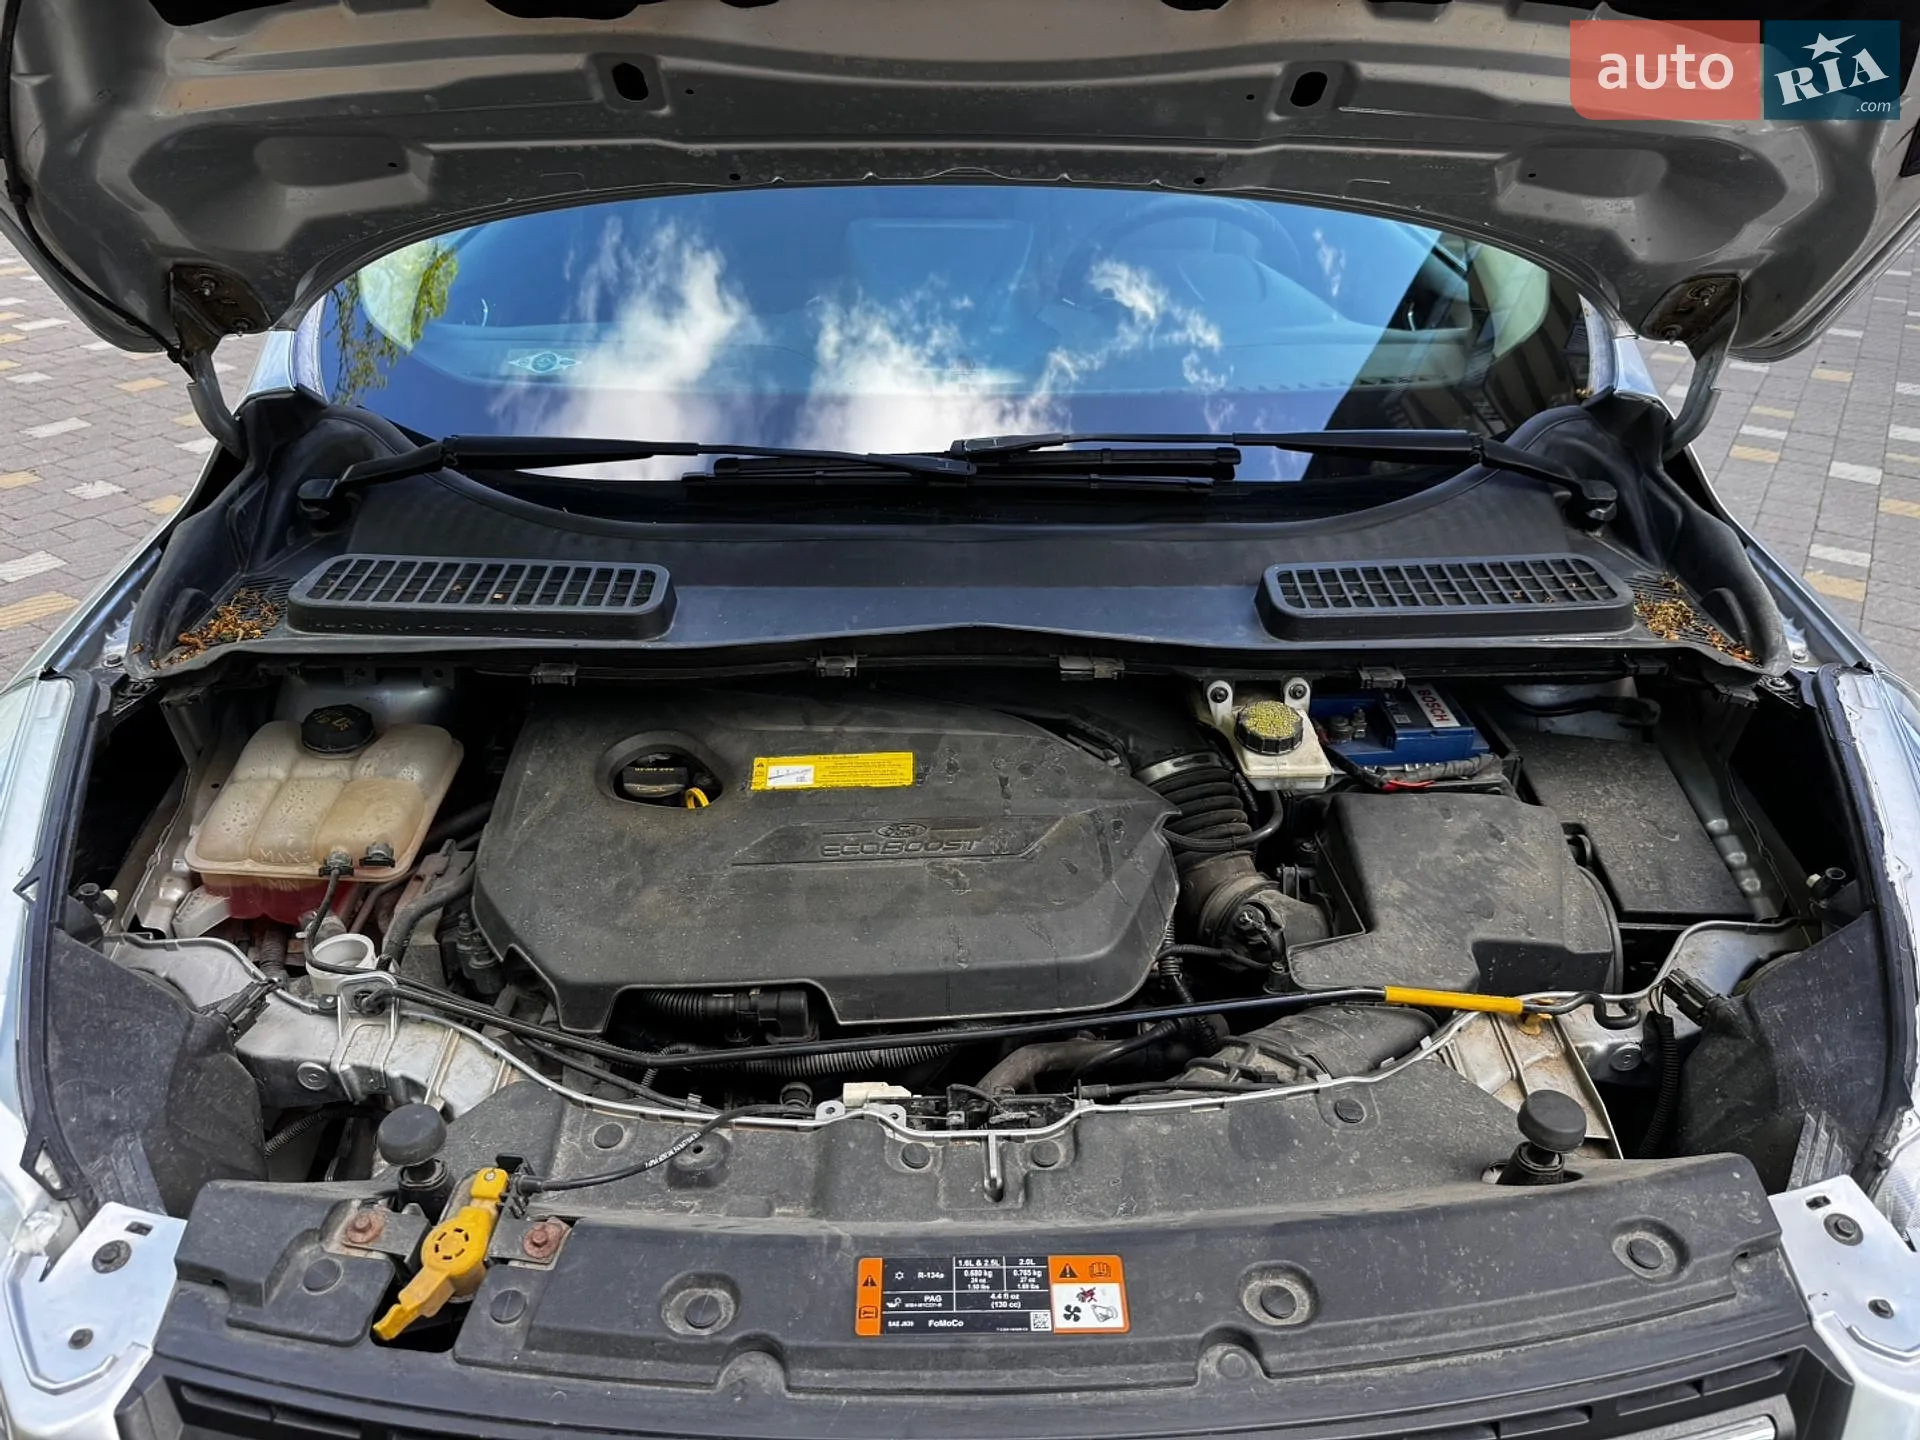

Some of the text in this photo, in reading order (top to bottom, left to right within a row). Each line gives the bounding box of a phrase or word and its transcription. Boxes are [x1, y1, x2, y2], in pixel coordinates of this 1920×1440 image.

[1416, 689, 1450, 722] BOSCH
[1018, 1258, 1036, 1266] 2.0L
[917, 1271, 945, 1279] R-134a
[983, 1269, 993, 1278] kg
[1033, 1269, 1042, 1278] kg
[923, 1294, 943, 1303] PAG
[928, 1319, 964, 1327] FoMoCo
